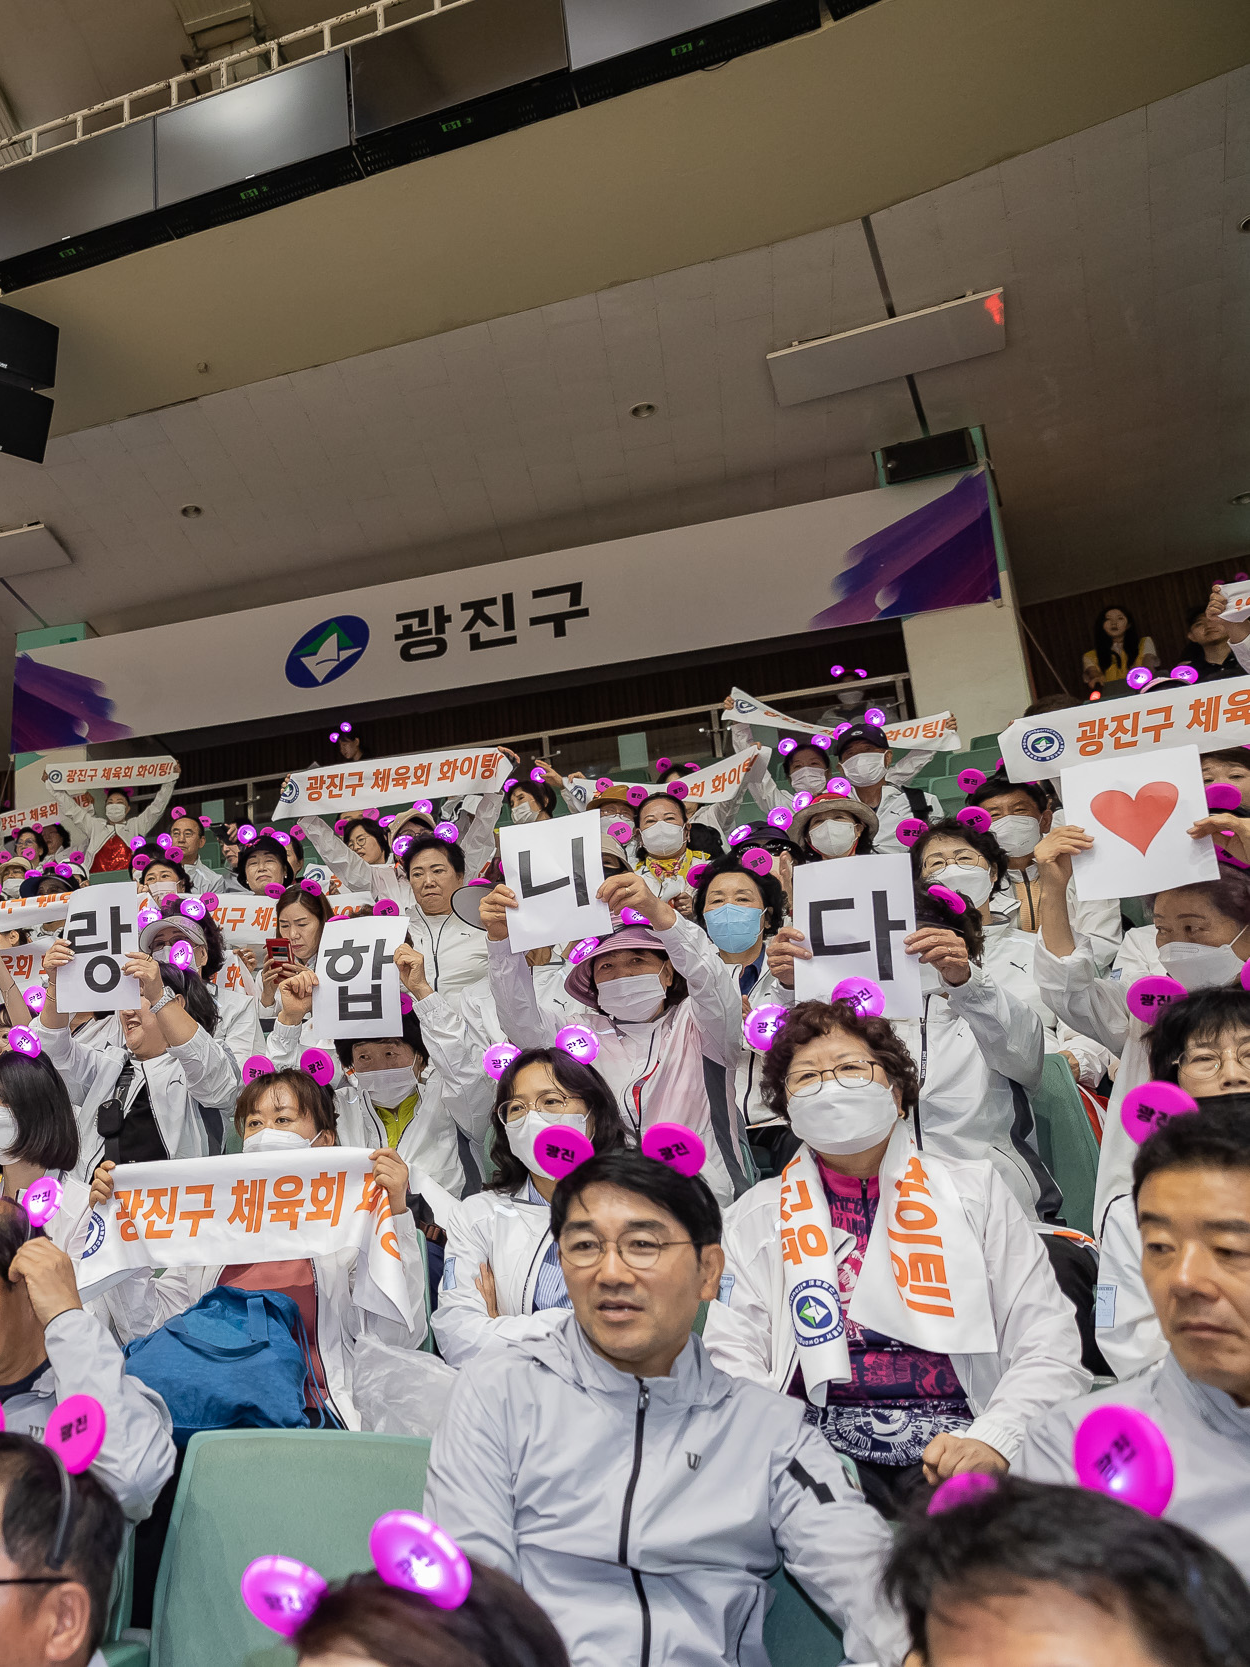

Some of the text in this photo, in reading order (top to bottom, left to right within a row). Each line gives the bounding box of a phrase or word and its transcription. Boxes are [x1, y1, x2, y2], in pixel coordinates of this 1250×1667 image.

[394, 581, 590, 662] 광진구
[886, 717, 946, 742] 화이팅!
[1076, 705, 1175, 757] 광진구
[66, 761, 174, 783] 광진구 체육회 화이팅!
[306, 770, 365, 801] 광진구
[370, 761, 432, 792] 체육회
[964, 777, 978, 785] 광진
[29, 802, 59, 823] 체육회
[966, 815, 983, 827] 광진
[614, 828, 627, 837] 광진
[903, 828, 921, 837] 광진
[749, 855, 765, 868] 광진
[518, 837, 590, 907] 니
[211, 907, 247, 931] 진구
[809, 890, 906, 981] 다
[67, 906, 132, 993] 랑
[324, 939, 394, 1021] 합
[28, 993, 42, 1002] 광진
[16, 1036, 30, 1051] 광진
[565, 1036, 587, 1054] 광진
[308, 1061, 324, 1074] 광진
[546, 1143, 575, 1163] 광진
[656, 1142, 689, 1161] 광진
[31, 1190, 52, 1204] 광진
[114, 1183, 216, 1242] 광진구
[227, 1171, 347, 1233] 체육회
